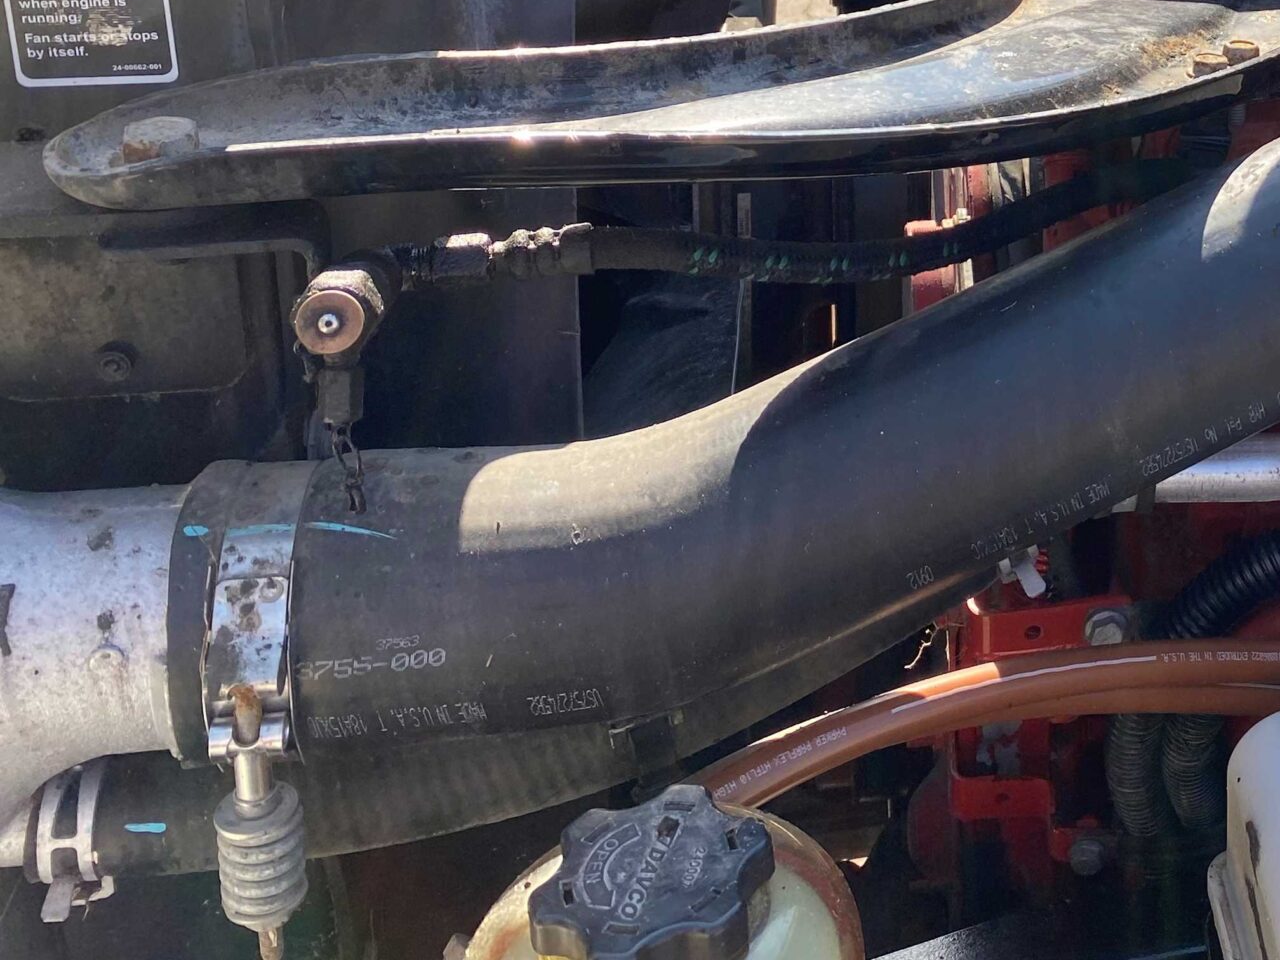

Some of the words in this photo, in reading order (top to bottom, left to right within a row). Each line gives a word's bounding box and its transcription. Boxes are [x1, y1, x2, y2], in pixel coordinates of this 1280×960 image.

[25, 33, 51, 44] Fan
[54, 31, 97, 43] starts
[100, 32, 116, 42] or
[27, 46, 44, 60] by
[48, 46, 89, 58] itself.
[906, 565, 934, 589] 0912
[375, 634, 420, 651] 37563
[297, 647, 447, 681] 3755-000
[1160, 650, 1185, 662] U.S.A.
[1187, 650, 1202, 660] THE
[435, 704, 453, 726] IN
[454, 701, 489, 723] MADE
[816, 726, 847, 747] PARKER
[713, 780, 737, 800] HIGH
[585, 839, 620, 885] OPEN
[618, 845, 666, 921] DAVCO
